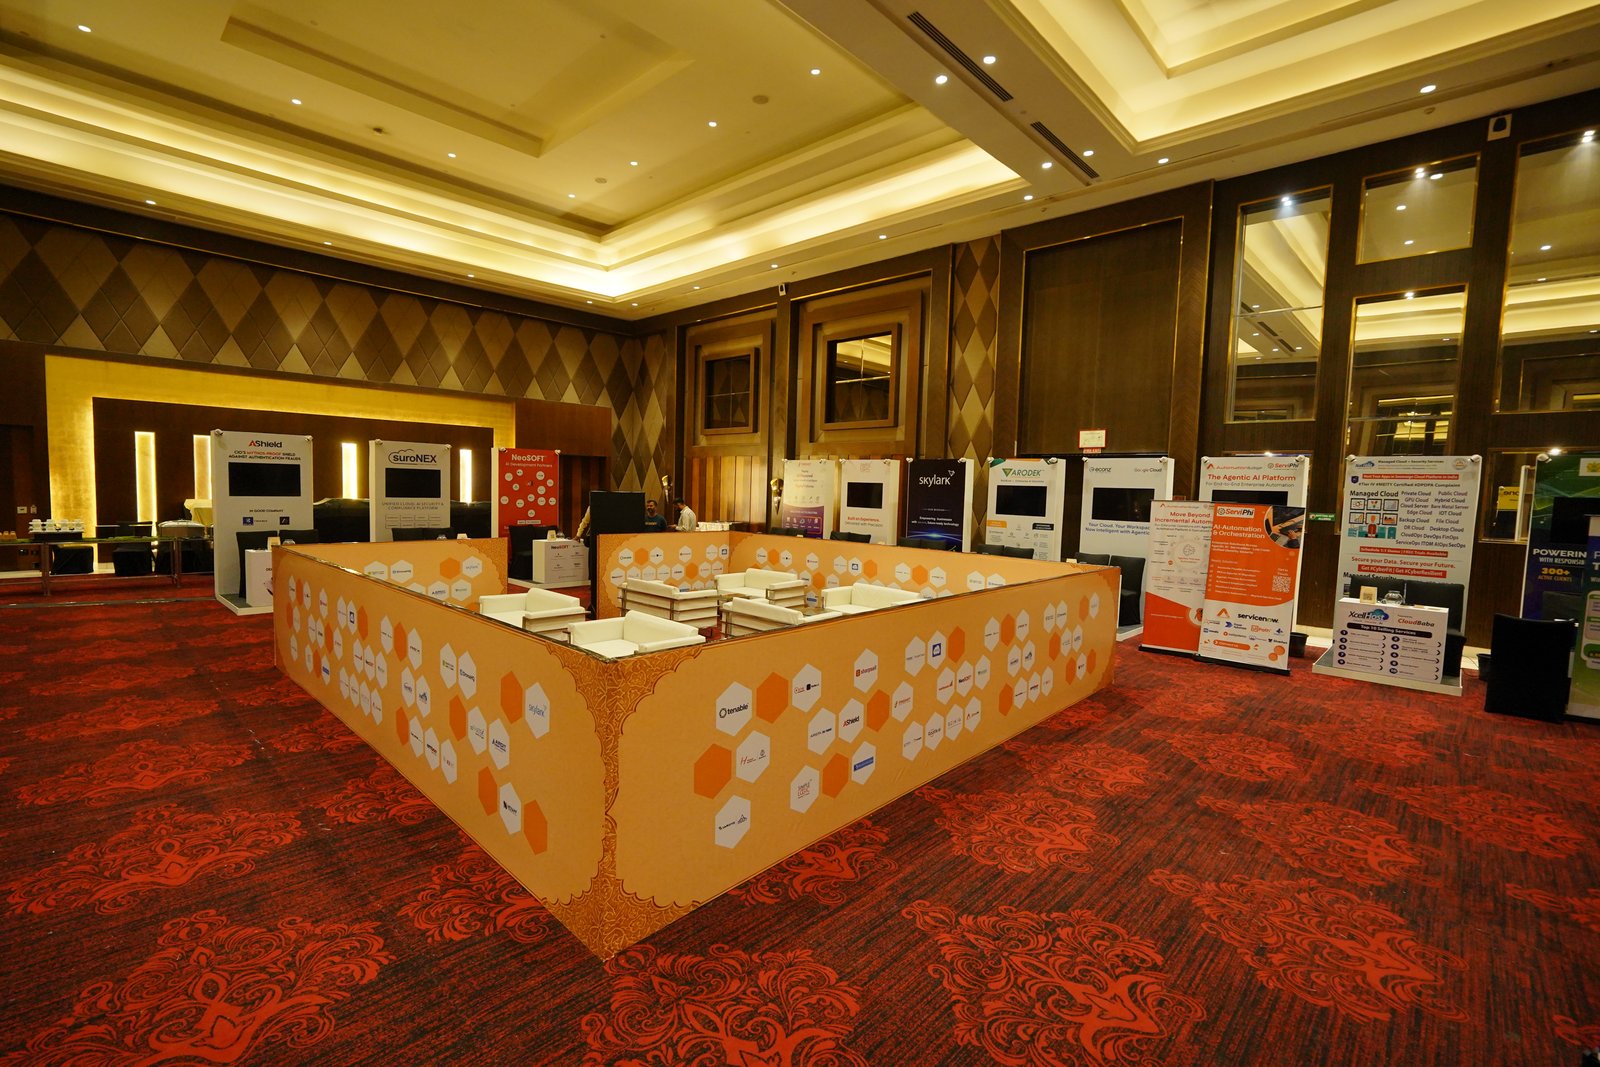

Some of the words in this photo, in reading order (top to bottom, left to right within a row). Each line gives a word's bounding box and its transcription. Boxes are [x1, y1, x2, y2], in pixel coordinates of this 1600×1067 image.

[248, 440, 282, 448] AShield
[393, 454, 437, 463] suroNEX
[919, 474, 951, 487] skylark
[1350, 490, 1378, 499] Managed
[1219, 530, 1265, 539] Orchestration
[1533, 548, 1587, 558] POWERIN
[1398, 618, 1434, 627] CloudBaba
[727, 704, 748, 715] tenable
